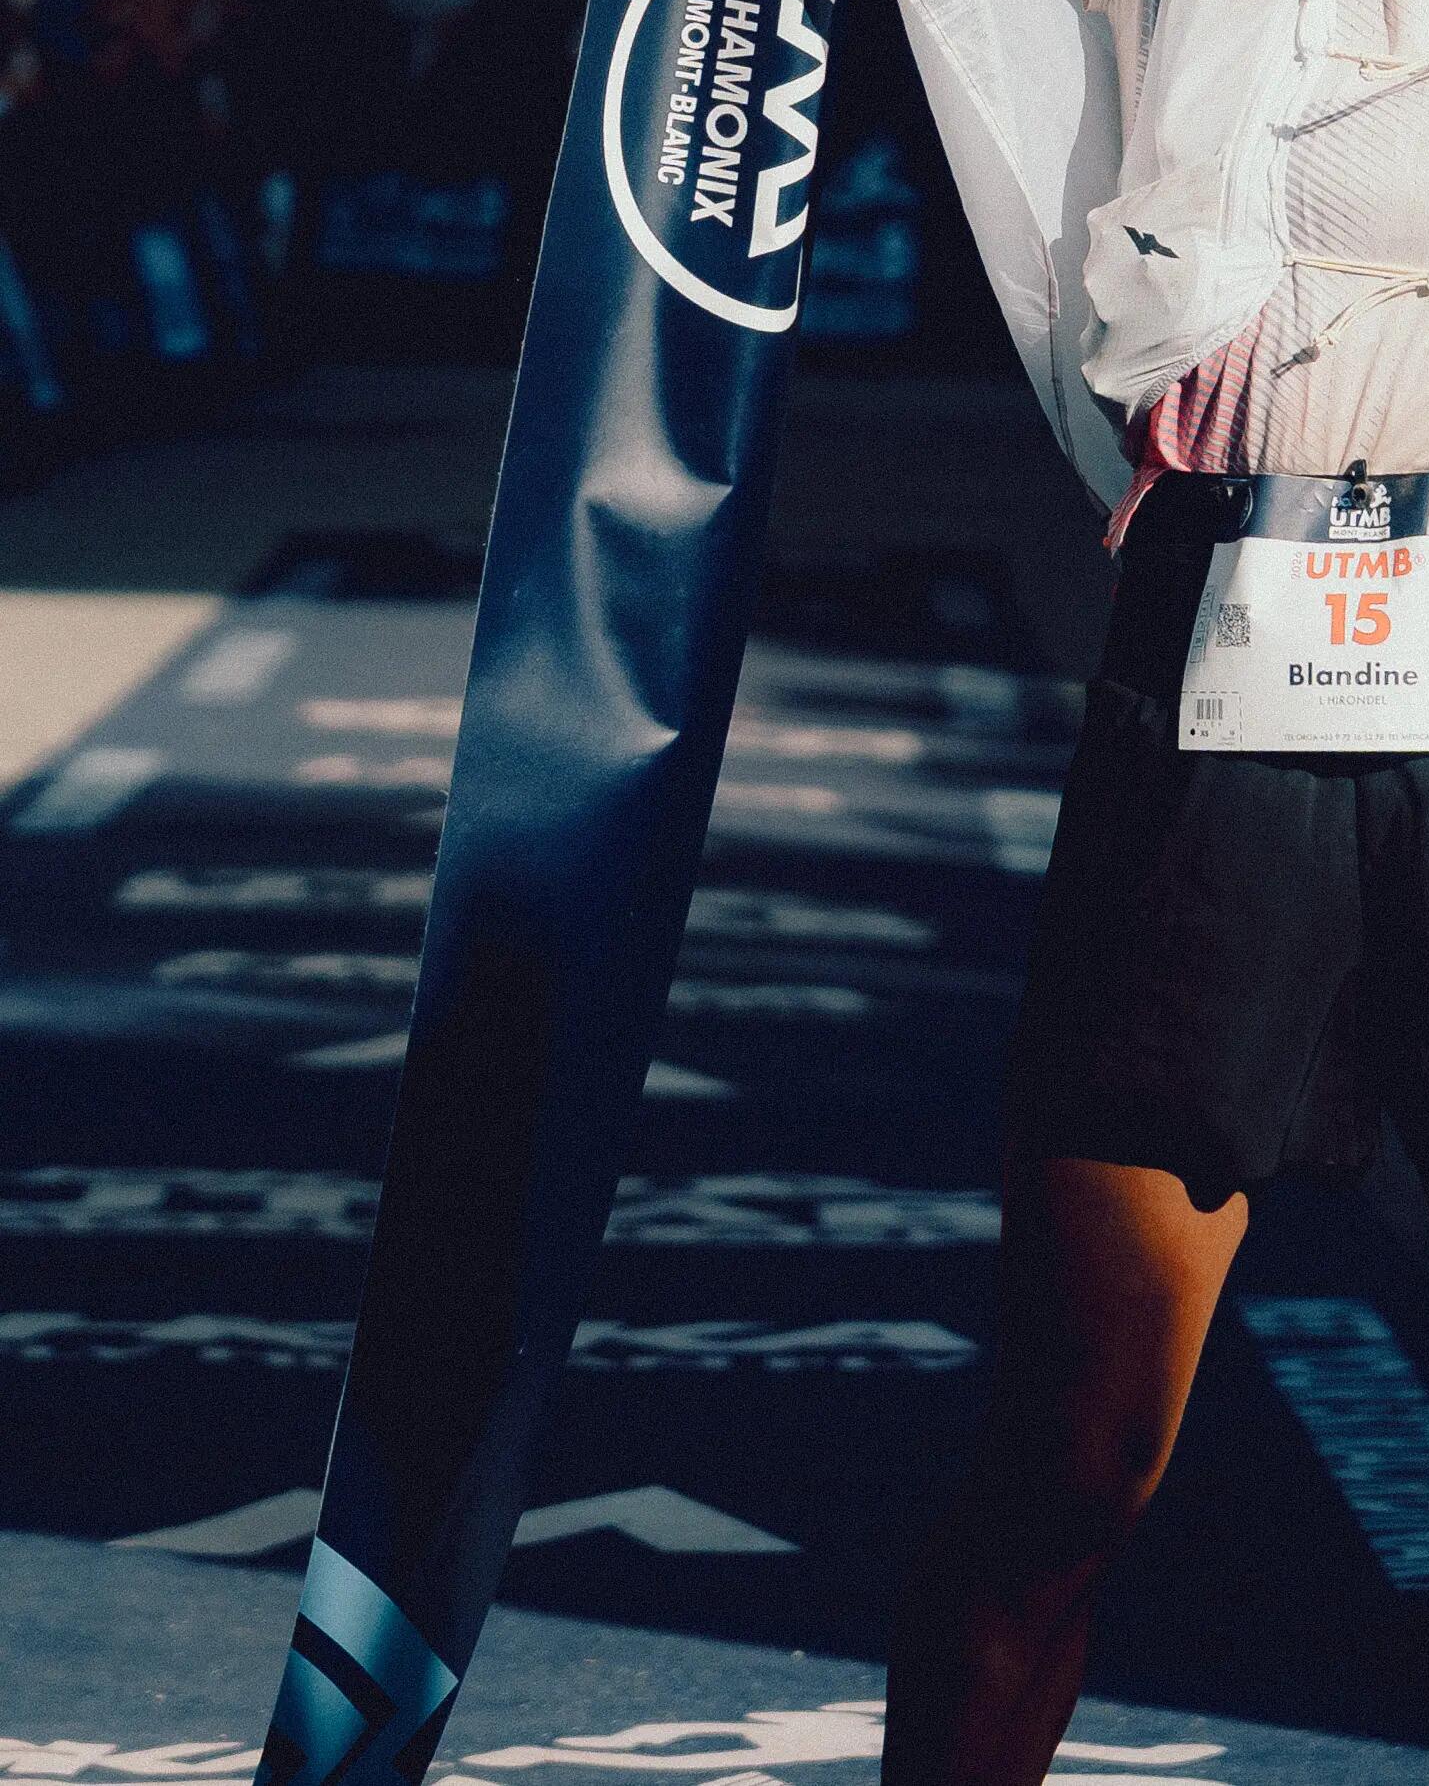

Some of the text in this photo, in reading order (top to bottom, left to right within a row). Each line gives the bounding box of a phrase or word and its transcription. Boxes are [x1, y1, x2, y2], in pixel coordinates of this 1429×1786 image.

[1329, 506, 1391, 527] UTMB
[1306, 547, 1414, 579] UTMB
[1325, 592, 1391, 646] 15
[1288, 662, 1418, 686] Blandine
